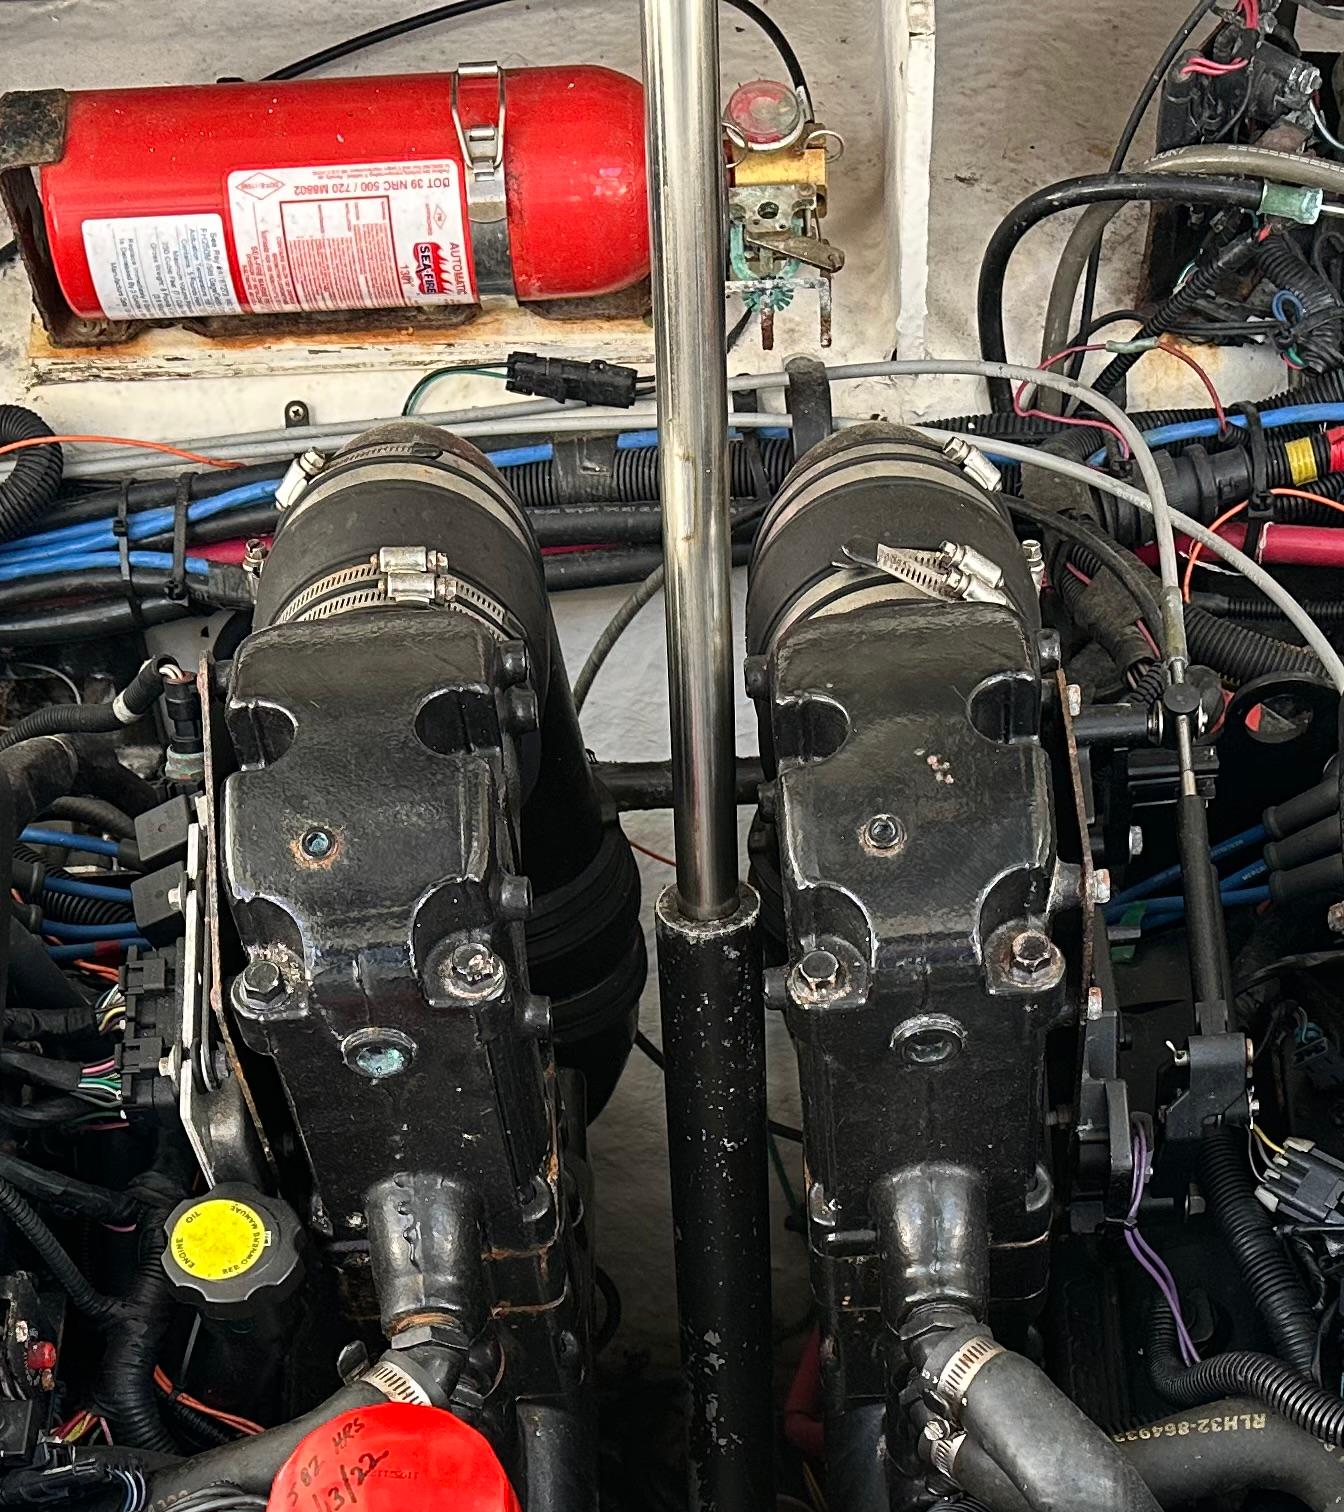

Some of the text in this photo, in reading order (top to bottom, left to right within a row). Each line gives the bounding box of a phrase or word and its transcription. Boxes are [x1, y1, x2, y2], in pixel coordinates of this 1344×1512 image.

[333, 183, 351, 193] 720
[361, 182, 380, 192] 500
[383, 180, 407, 191] NRC
[410, 179, 423, 190] 39
[427, 178, 450, 189] DOT
[230, 1203, 259, 1230] MANUAL
[175, 1210, 202, 1269] ENGINE OIL
[332, 1417, 365, 1455] HRS
